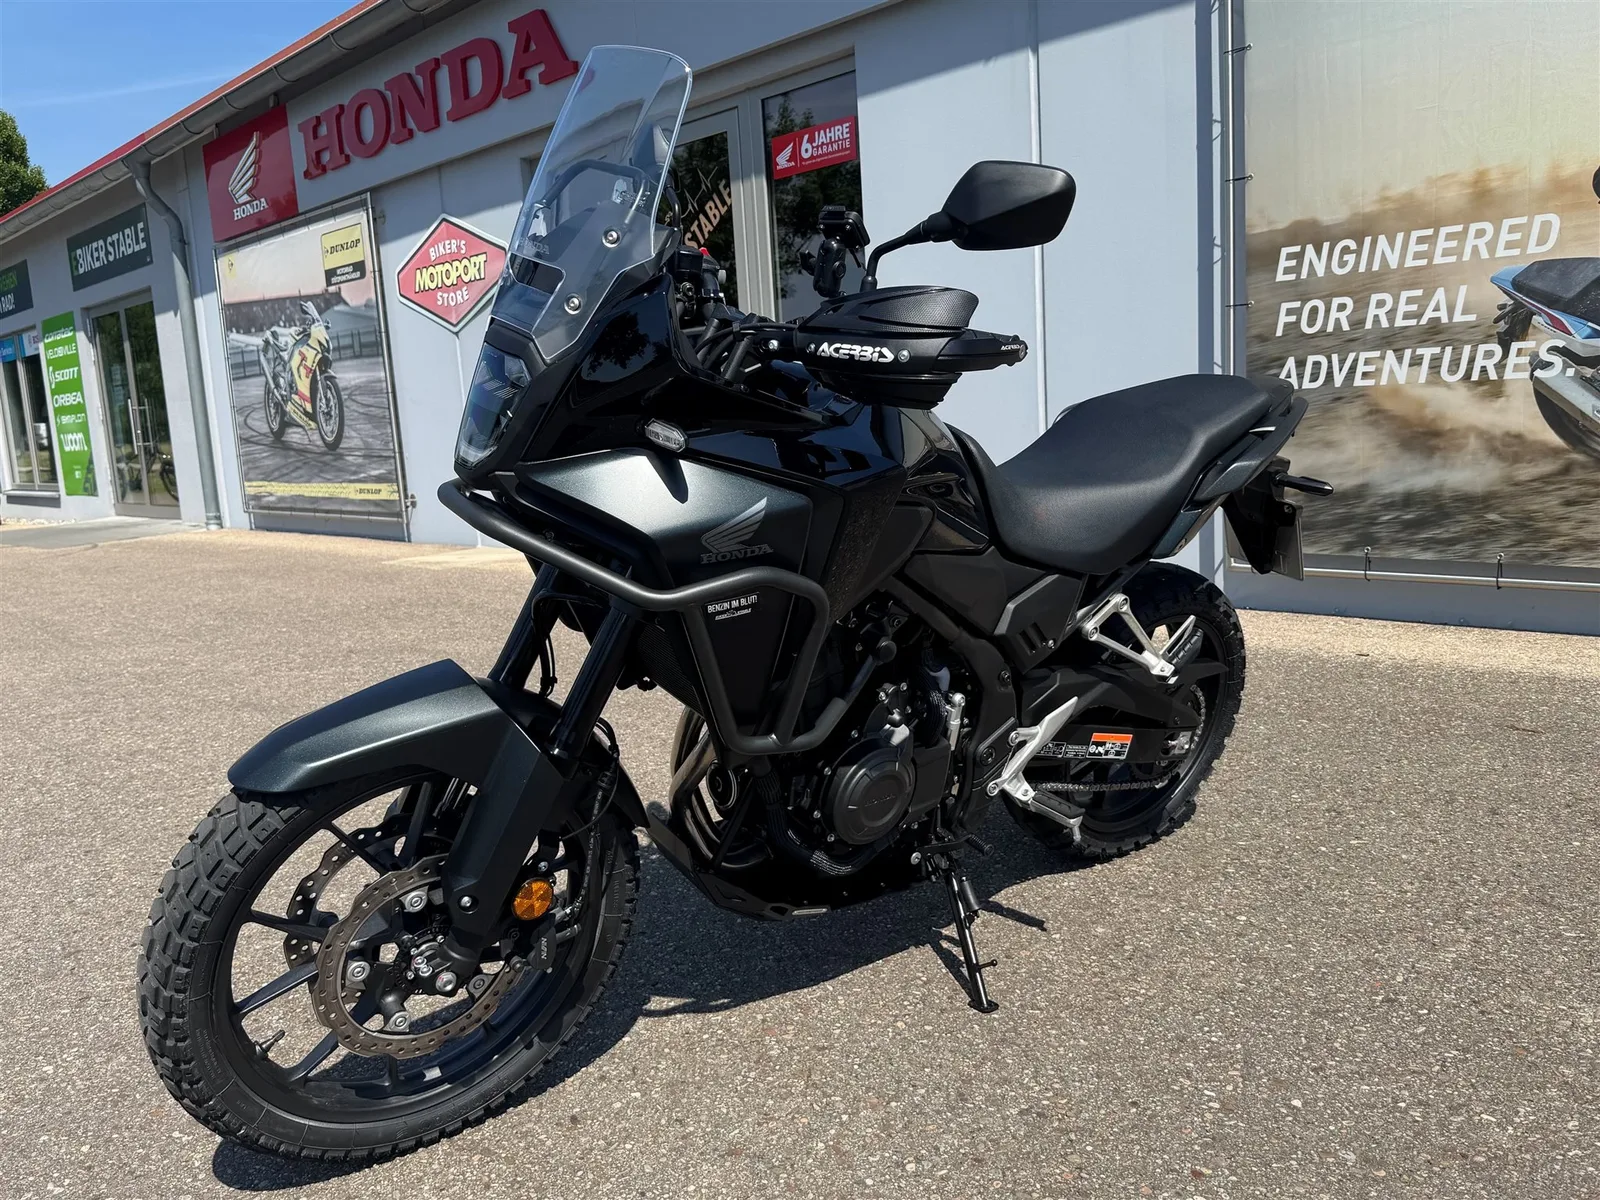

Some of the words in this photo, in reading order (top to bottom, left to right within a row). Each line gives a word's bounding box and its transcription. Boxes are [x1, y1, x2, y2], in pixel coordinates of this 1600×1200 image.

[298, 9, 580, 180] HONDA
[801, 133, 812, 159] 6
[812, 139, 851, 156] GARANTIE
[233, 198, 268, 221] HONDA
[684, 178, 732, 250] STABLE
[107, 221, 147, 262] STABLE
[329, 238, 361, 255] DUNLOP
[429, 239, 466, 262] BIKER'S
[1275, 213, 1561, 282] ENGINEERED
[415, 252, 487, 294] MOTOPORT
[437, 286, 469, 307] STORE
[1275, 296, 1354, 337] FOR
[1364, 285, 1478, 330] REAL
[55, 366, 79, 382] SCOTT
[1277, 339, 1576, 390] ADVENTURES.
[53, 391, 84, 408] ORBEA
[700, 544, 774, 564] HONDA
[707, 601, 730, 614] BENZIN
[731, 599, 740, 609] IM
